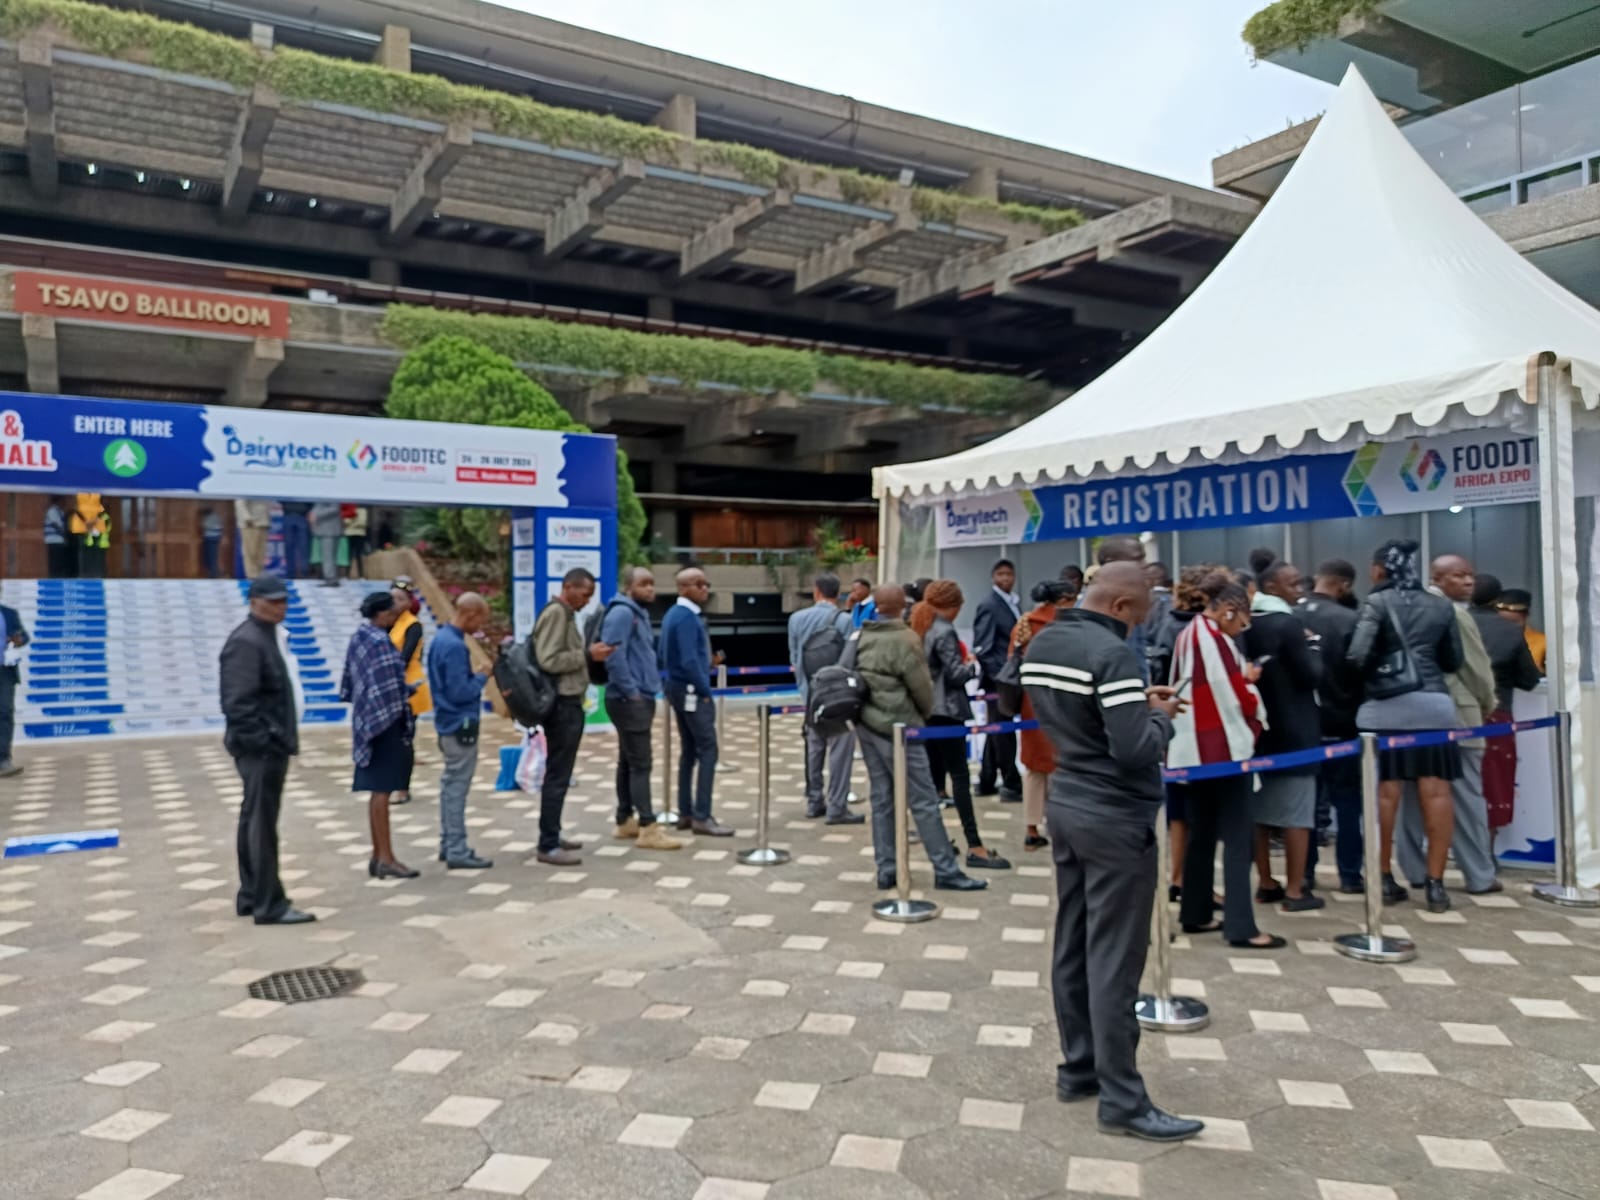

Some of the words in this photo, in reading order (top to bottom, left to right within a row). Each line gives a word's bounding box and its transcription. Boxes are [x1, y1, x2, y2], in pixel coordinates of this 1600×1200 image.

[38, 283, 129, 313] TSAVO
[136, 293, 271, 327] BALLROOM
[4, 415, 19, 437] &
[74, 415, 126, 435] ENTER
[130, 418, 174, 438] HERE
[226, 436, 337, 467] Dairytech
[381, 445, 447, 466] FOODTEC
[1453, 437, 1539, 473] FOODT
[1454, 471, 1496, 488] AFRICA
[1499, 468, 1530, 484] EXPO
[1063, 466, 1309, 529] REGISTRATION
[946, 506, 1009, 534] Dairytech
